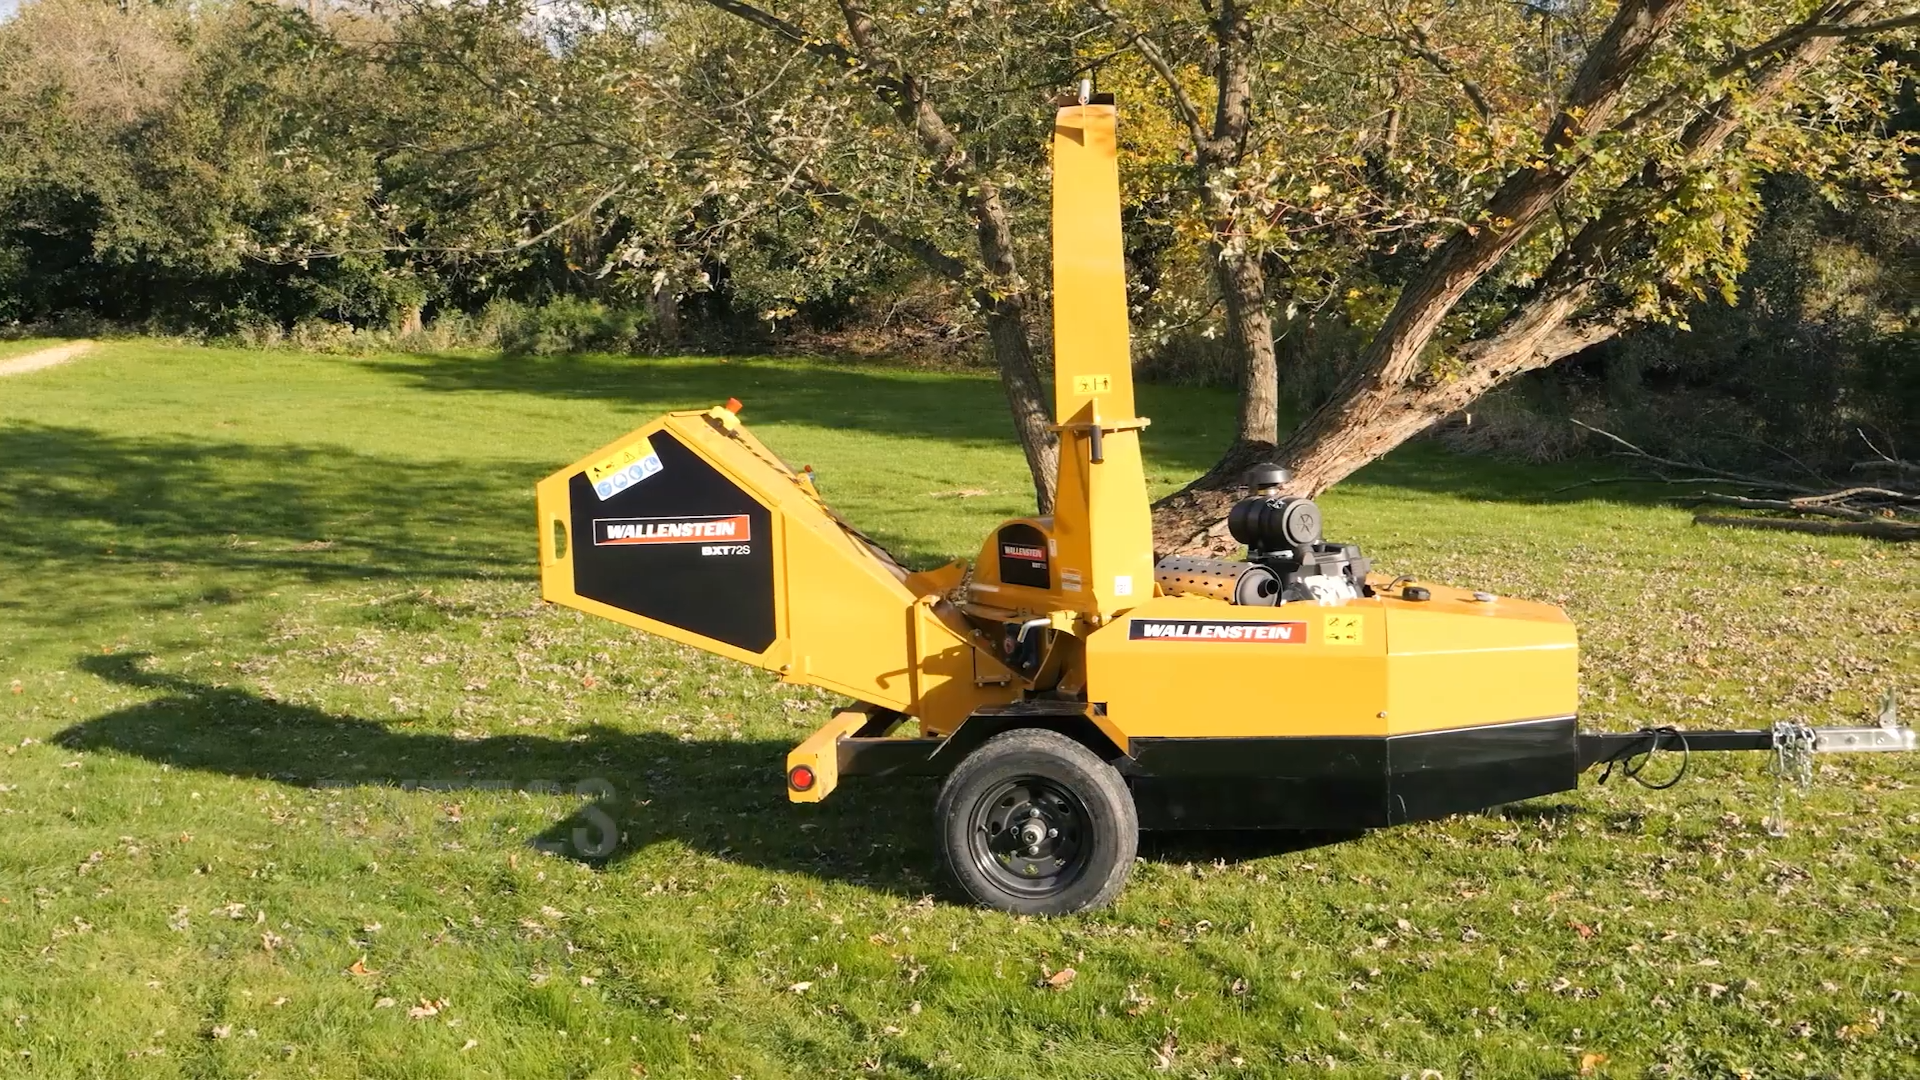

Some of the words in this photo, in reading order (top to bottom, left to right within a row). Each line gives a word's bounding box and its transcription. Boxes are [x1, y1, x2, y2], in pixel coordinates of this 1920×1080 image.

[606, 522, 736, 539] WALLENSTEIN
[701, 546, 750, 556] BXT72S
[1142, 624, 1292, 640] WALLENSTEIN
